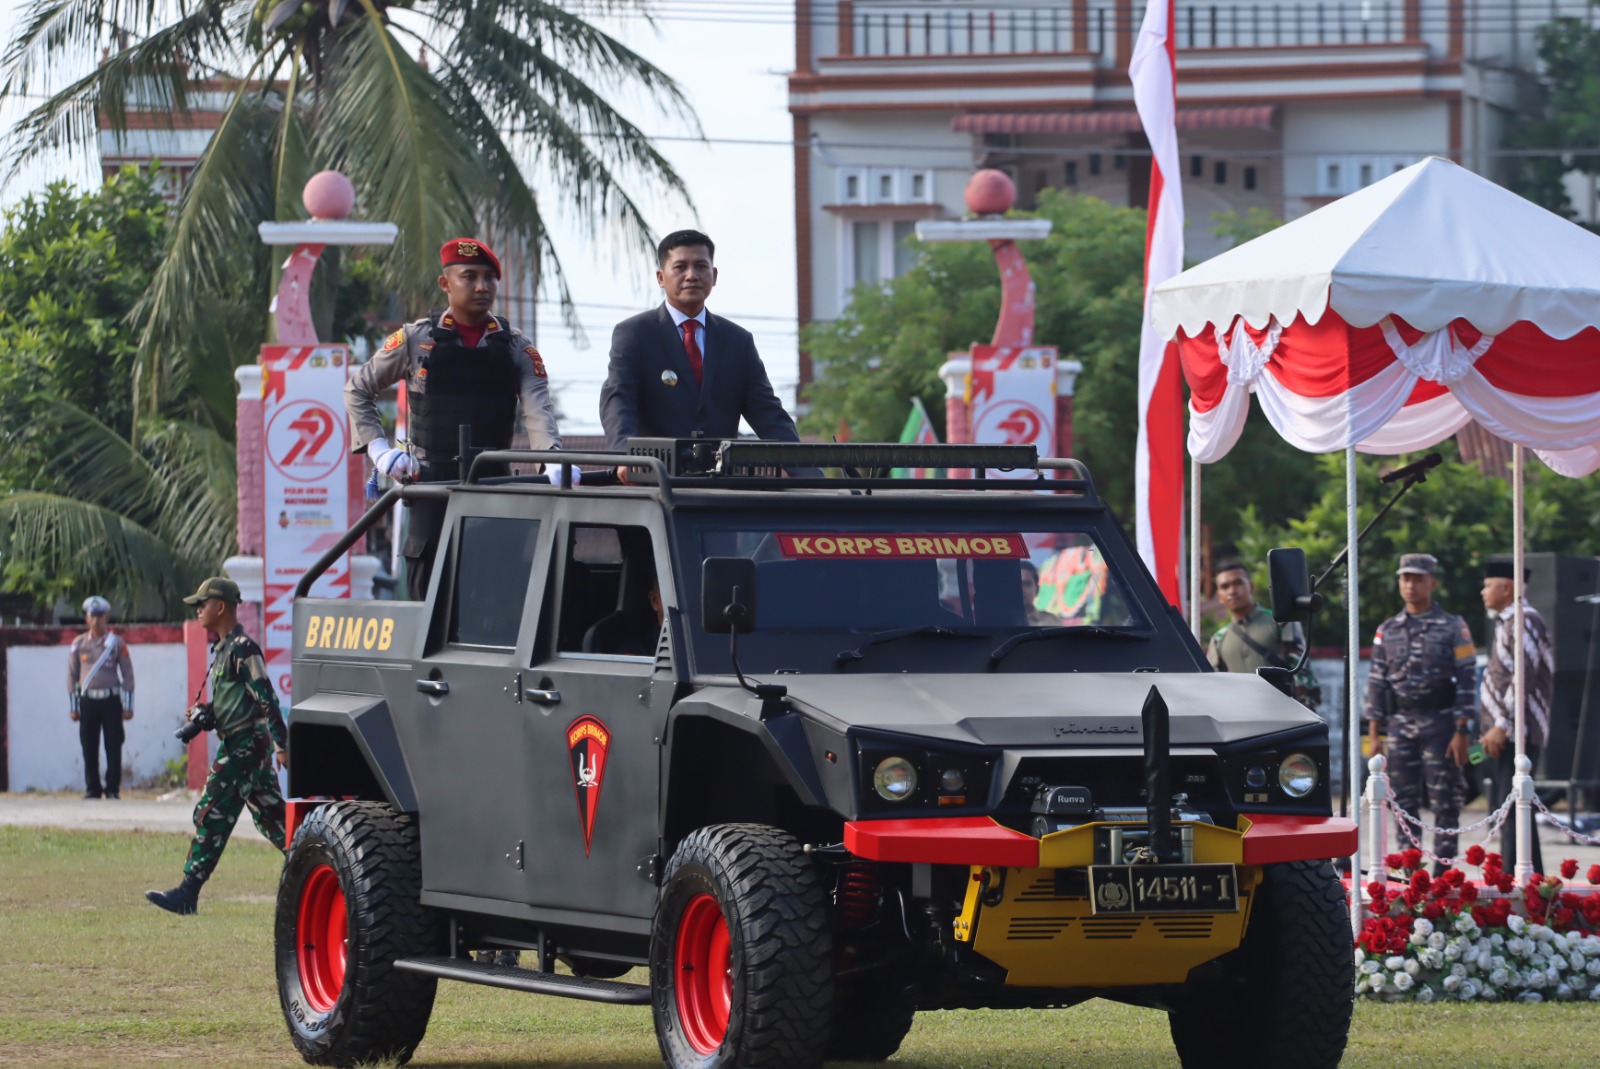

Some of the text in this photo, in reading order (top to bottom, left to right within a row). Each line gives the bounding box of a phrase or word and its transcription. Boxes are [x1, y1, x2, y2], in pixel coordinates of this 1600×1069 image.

[792, 537, 1012, 555] KORPS BRIMOB
[305, 615, 394, 651] BRIMOB
[570, 724, 607, 746] KORPS BRIMOB
[1057, 795, 1085, 803] Runva
